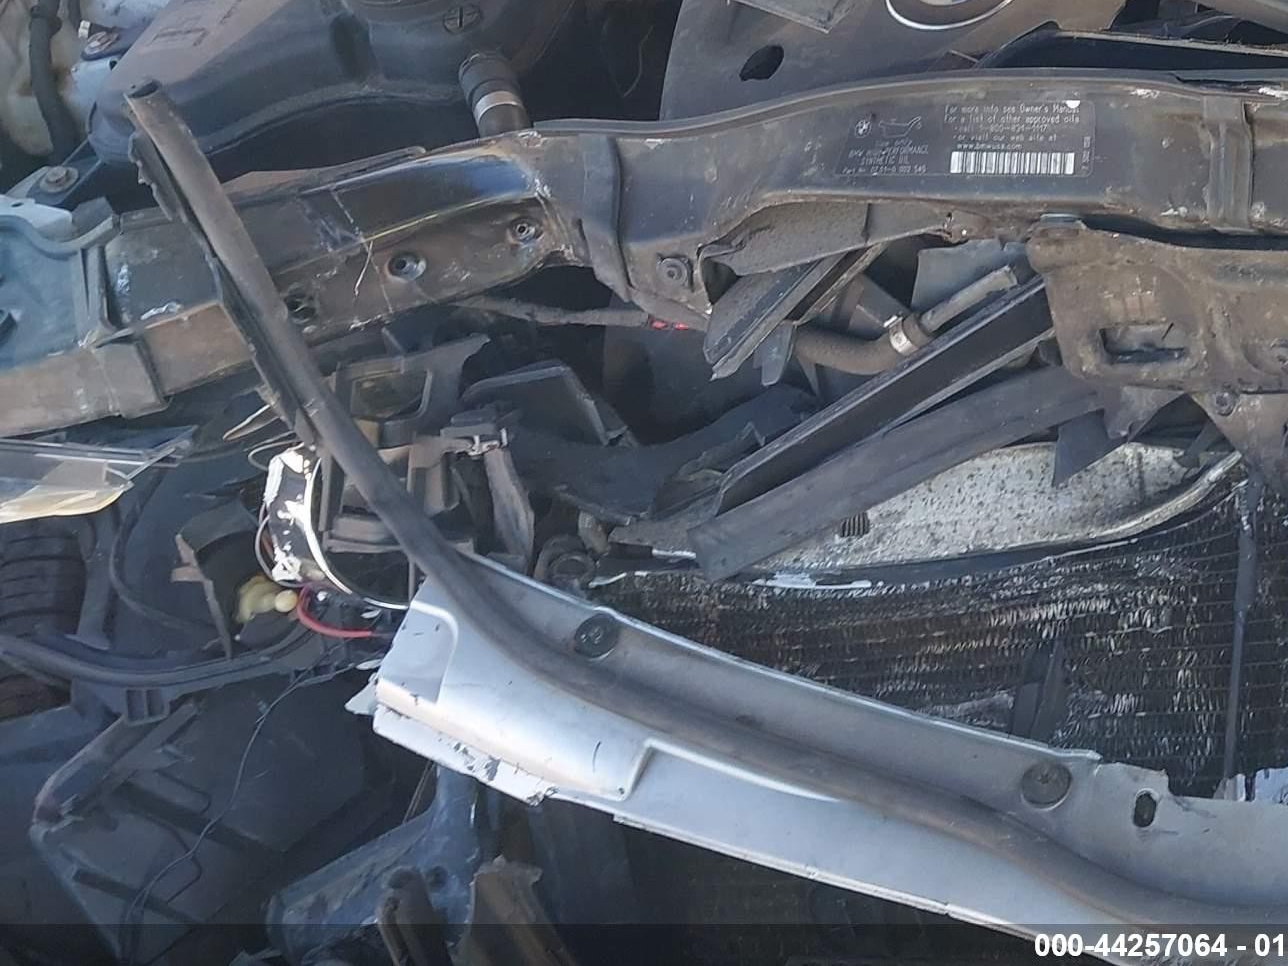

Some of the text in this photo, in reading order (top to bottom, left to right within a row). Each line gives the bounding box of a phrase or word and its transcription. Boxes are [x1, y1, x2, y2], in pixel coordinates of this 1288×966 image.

[944, 104, 957, 114] For
[1020, 103, 1049, 114] Owner's
[944, 113, 957, 123] For
[1000, 113, 1021, 123] other
[1025, 113, 1060, 124] approved
